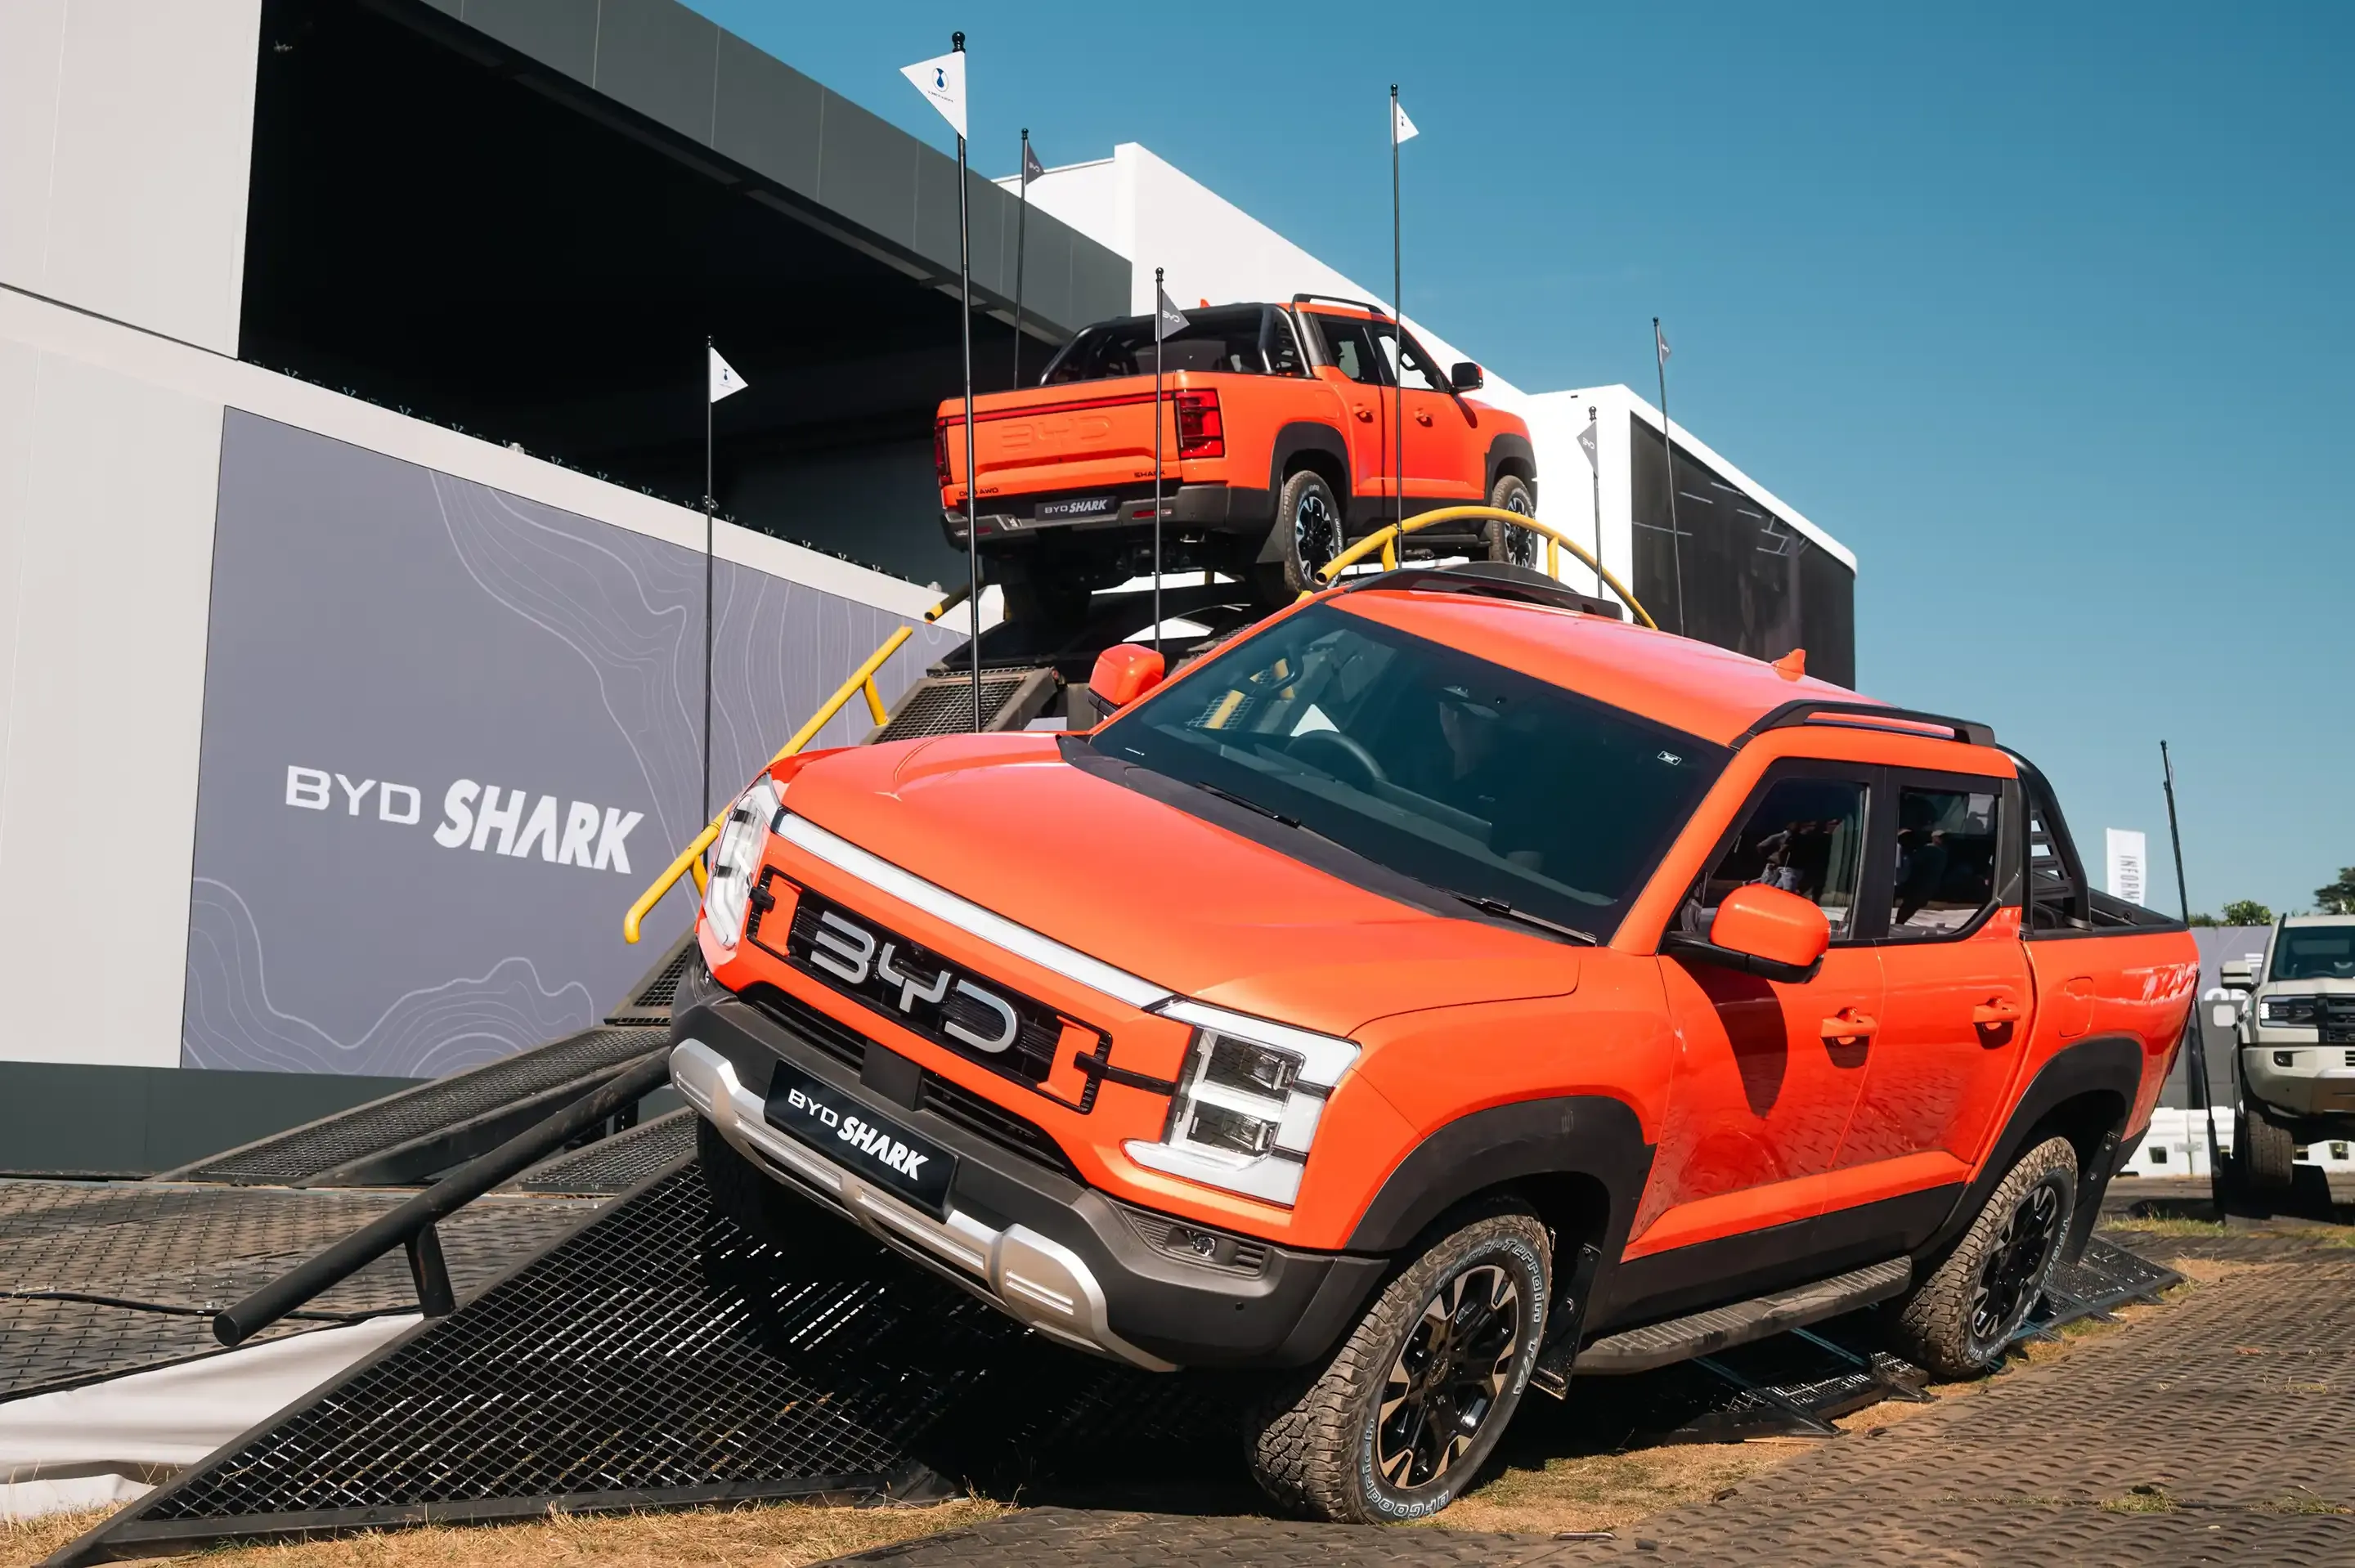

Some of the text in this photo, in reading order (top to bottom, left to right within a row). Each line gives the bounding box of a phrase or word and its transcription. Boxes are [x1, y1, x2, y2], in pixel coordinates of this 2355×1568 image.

[1002, 415, 1113, 455] BYD
[1044, 500, 1107, 513] BYD SHARK
[286, 765, 644, 874] BYD SHARK
[2119, 855, 2140, 906] INFORM
[810, 911, 1016, 1053] BYD
[787, 1088, 929, 1180] BYD SHARK
